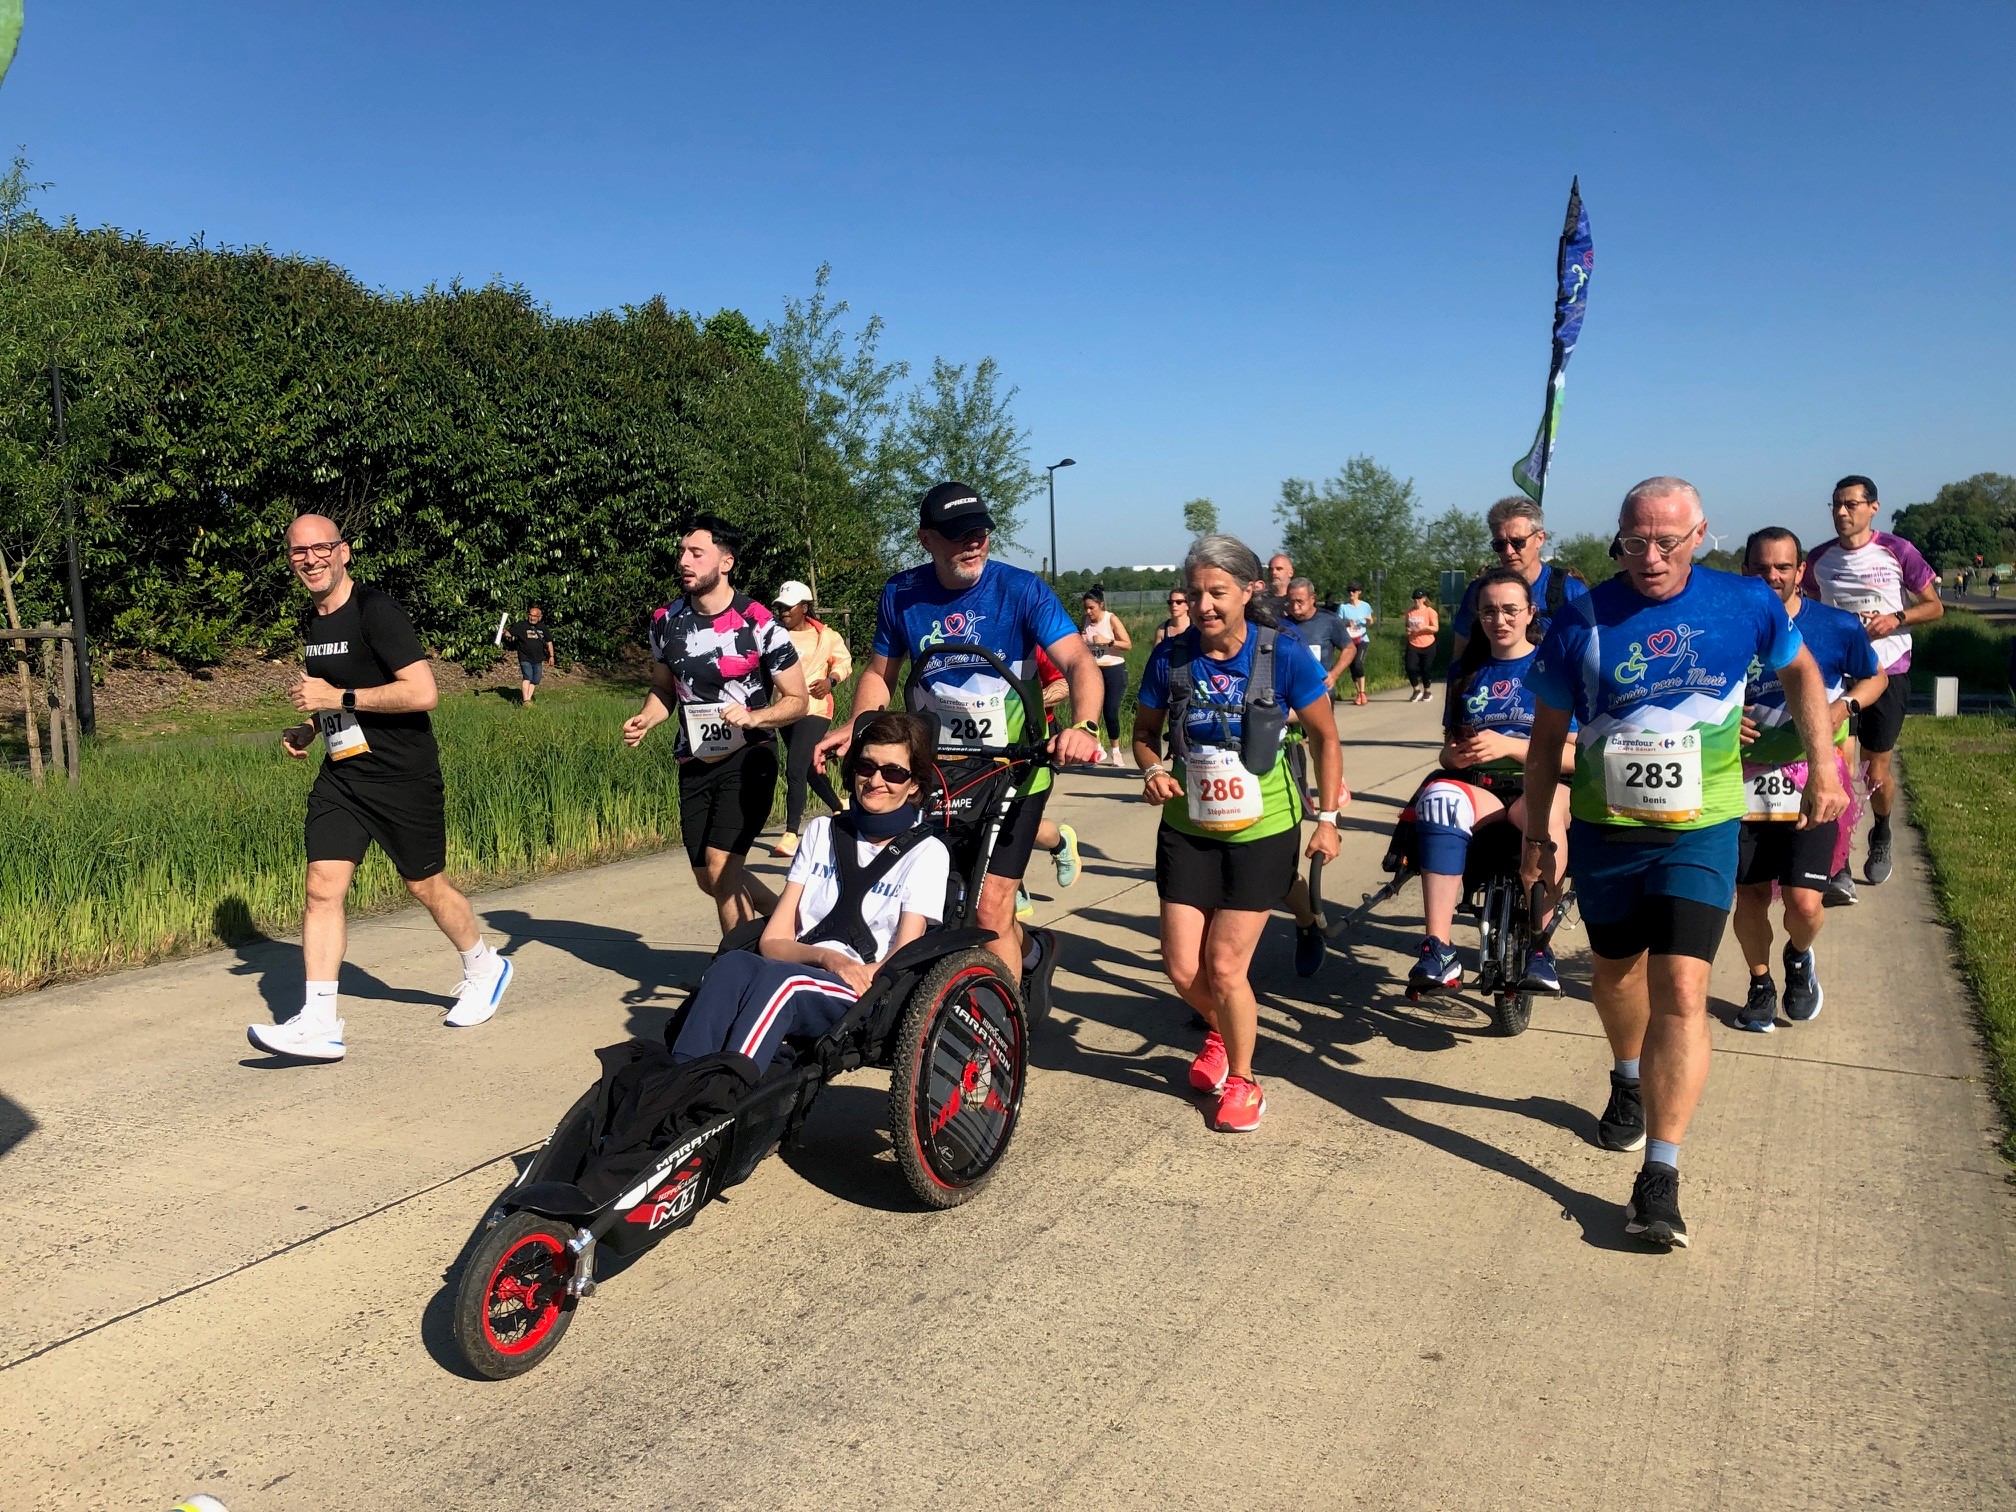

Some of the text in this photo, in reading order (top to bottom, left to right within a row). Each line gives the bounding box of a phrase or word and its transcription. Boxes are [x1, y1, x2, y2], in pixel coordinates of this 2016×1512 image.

[1684, 667, 1728, 687] Marie
[939, 697, 970, 707] Carrefour
[322, 713, 344, 738] 297
[700, 722, 732, 742] 296
[950, 718, 994, 740] 282
[1611, 737, 1654, 748] Carrefour
[1625, 762, 1683, 789] 283
[1753, 775, 1796, 796] 289
[1199, 776, 1245, 802] 286
[1642, 795, 1667, 805] Denis
[1207, 806, 1242, 817] Stéphanie
